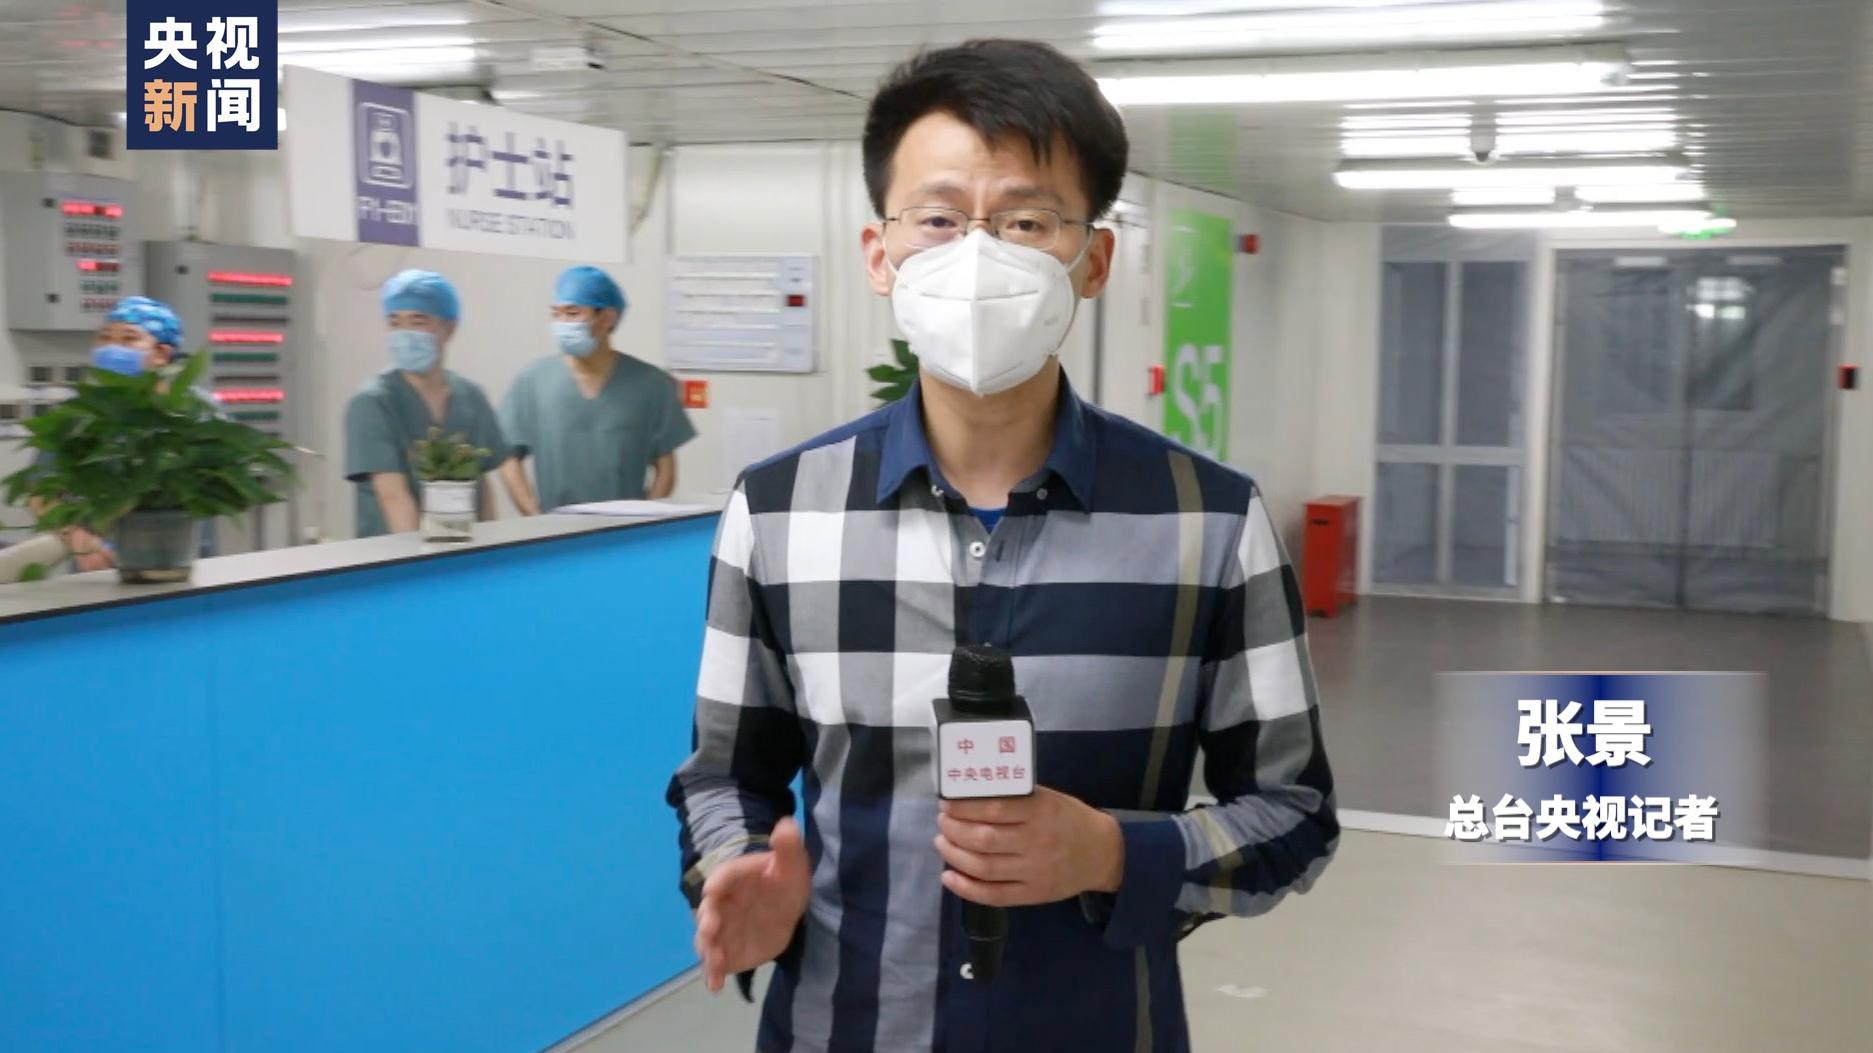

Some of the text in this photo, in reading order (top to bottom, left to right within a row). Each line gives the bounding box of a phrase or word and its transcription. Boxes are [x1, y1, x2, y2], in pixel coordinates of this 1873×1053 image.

[446, 122, 574, 207] 护士站
[446, 208, 503, 233] NURSE
[506, 214, 576, 239] STATION
[1174, 343, 1225, 459] S5
[957, 736, 1016, 754] 中国
[947, 765, 1025, 781] 中央电视台
